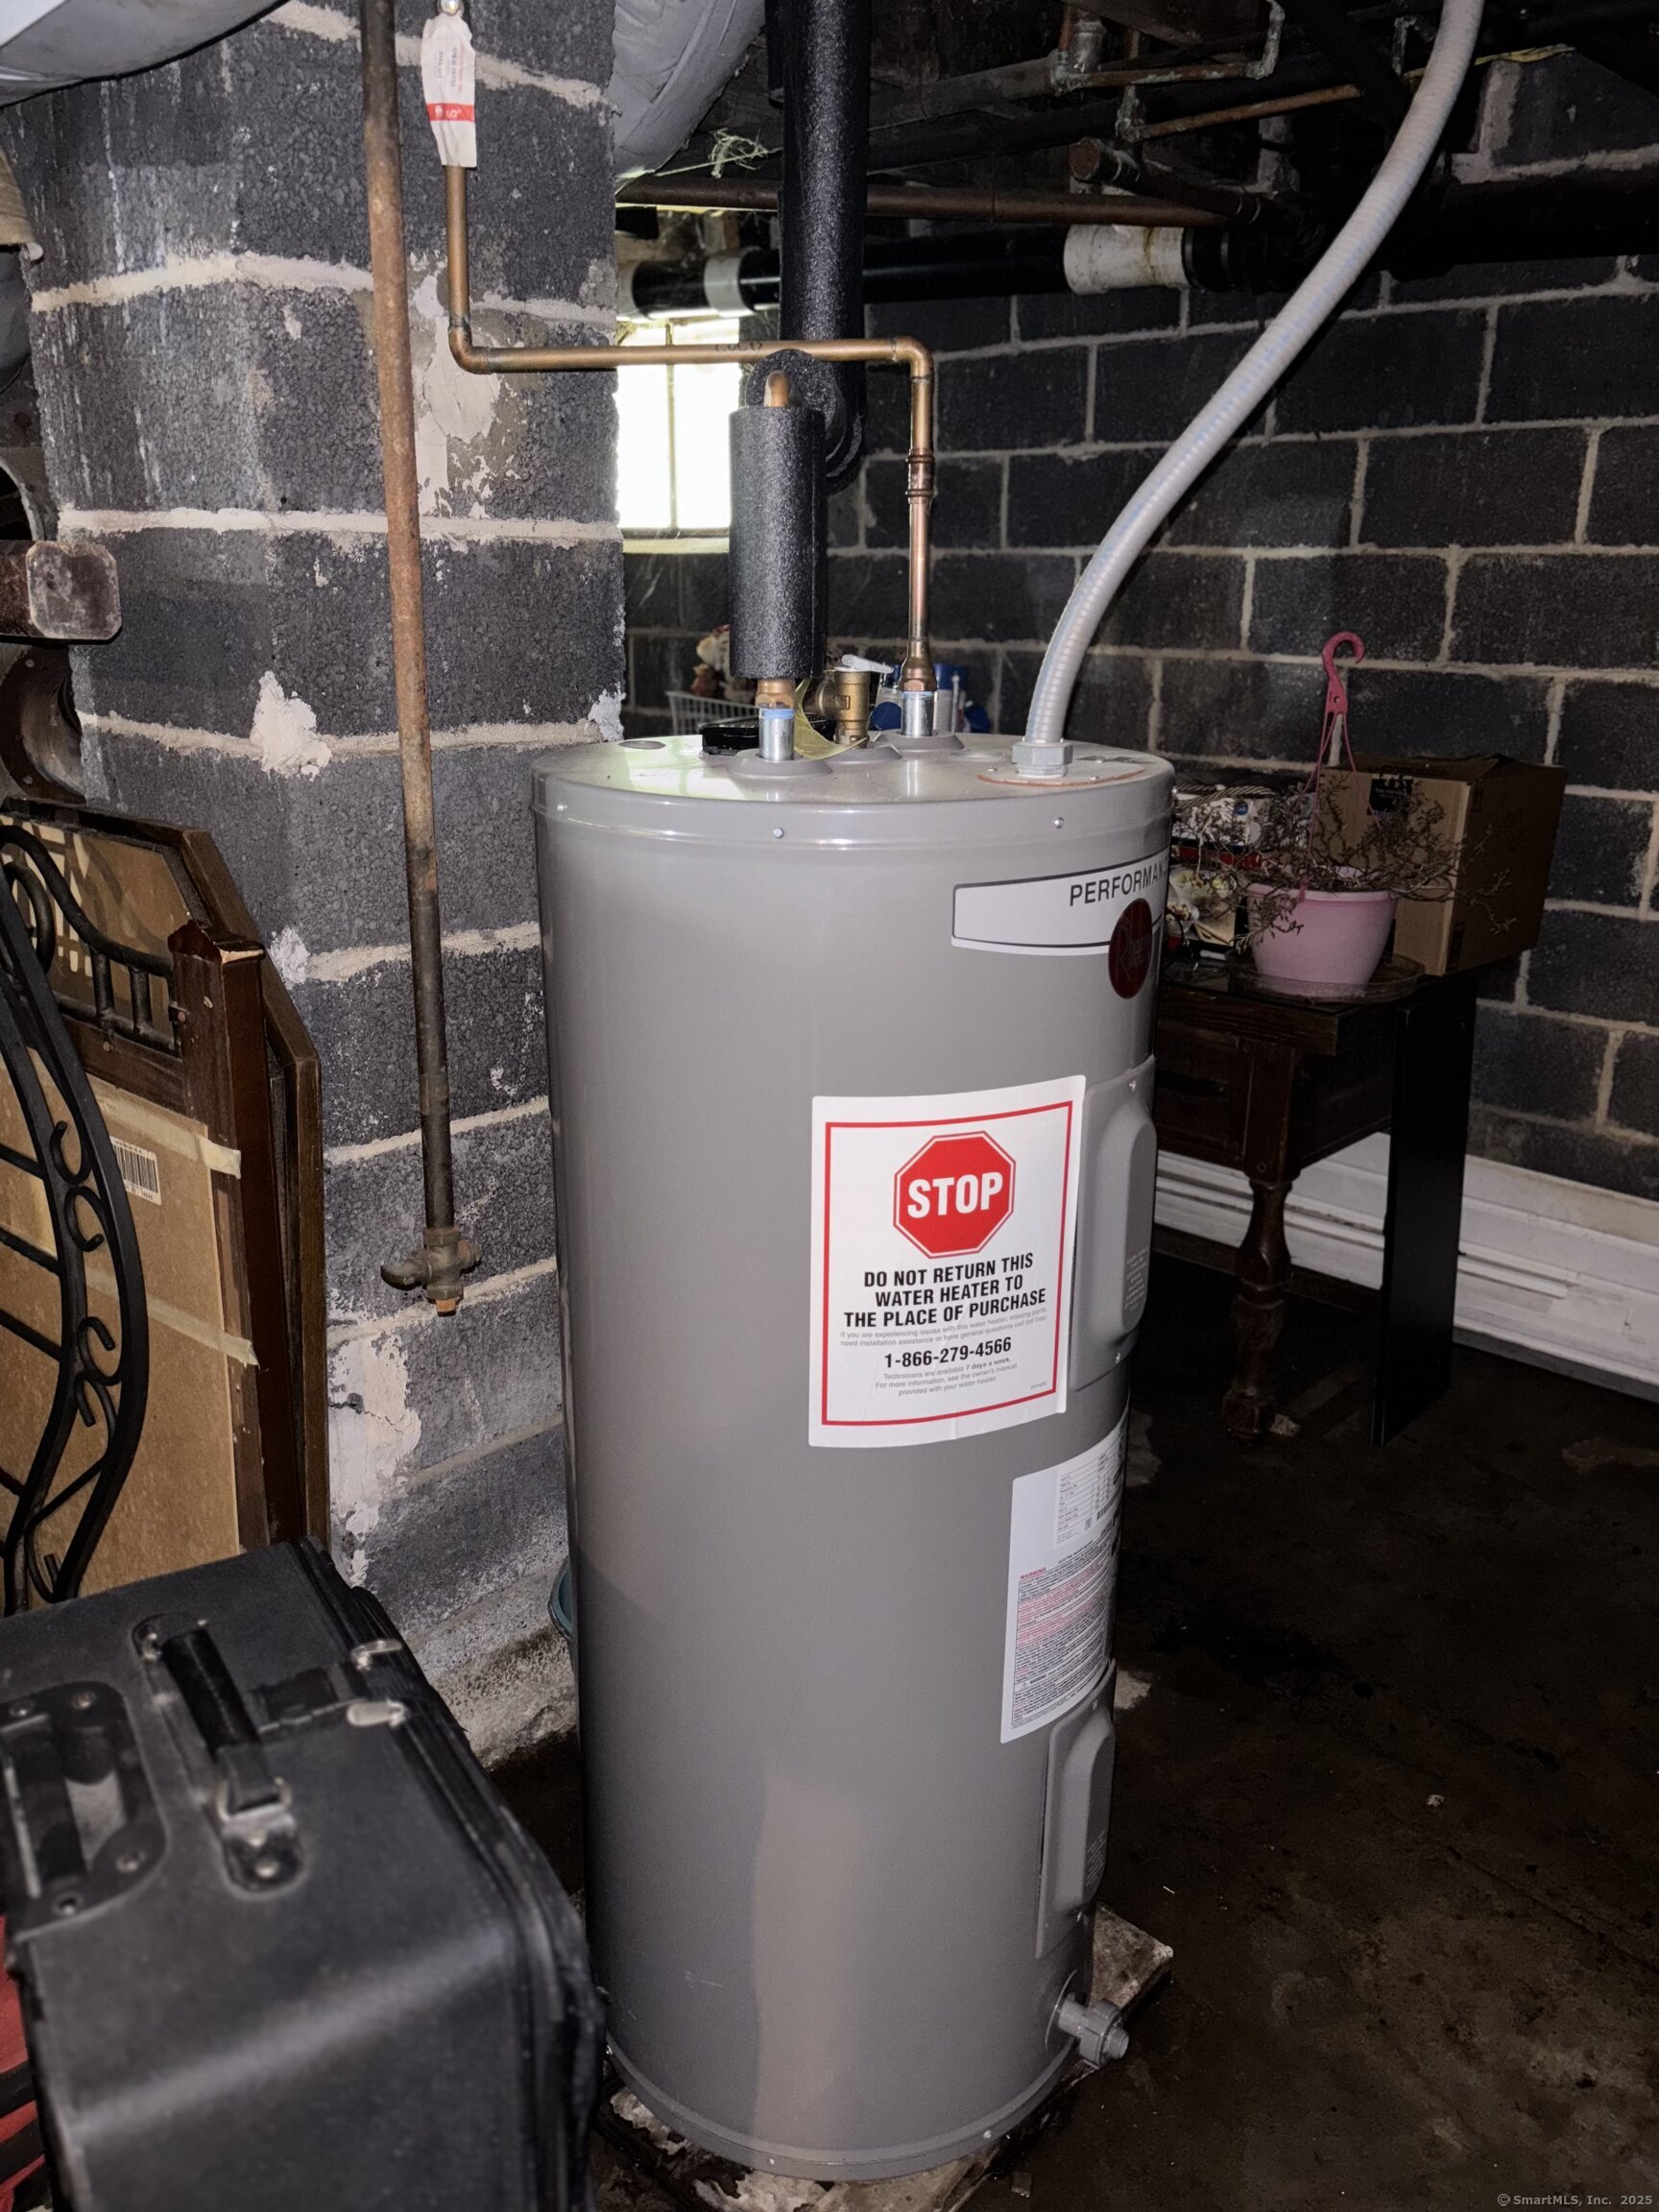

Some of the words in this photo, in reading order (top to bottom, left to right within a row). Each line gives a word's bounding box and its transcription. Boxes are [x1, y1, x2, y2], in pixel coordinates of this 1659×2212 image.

[907, 1171, 1003, 1219] STOP
[864, 1271, 887, 1286] DO
[894, 1269, 927, 1286] NOT
[933, 1260, 996, 1284] RETURN
[1001, 1252, 1033, 1273] THIS
[876, 1288, 933, 1307] WATER
[940, 1279, 999, 1303] HEATER
[1005, 1274, 1023, 1291] TO
[844, 1311, 877, 1328] THE
[883, 1308, 937, 1327] PLACE
[943, 1305, 963, 1322] OF
[970, 1287, 1046, 1318] PURCHASE
[875, 1329, 918, 1339] experiencing
[943, 1324, 955, 1333] with
[1009, 1311, 1031, 1322] missing
[1032, 1308, 1046, 1316] parts
[899, 1337, 933, 1346] assistance
[960, 1330, 984, 1340] general
[985, 1323, 1013, 1334] questions
[1015, 1319, 1024, 1328] call
[884, 1336, 1012, 1368] 1-866-279-4566
[908, 1378, 946, 1387] information,
[972, 1368, 995, 1378] owner's
[996, 1363, 1018, 1373] manual
[936, 1366, 964, 1376] available
[972, 1361, 986, 1370] days
[899, 1388, 927, 1397] provided
[943, 1383, 957, 1392] your
